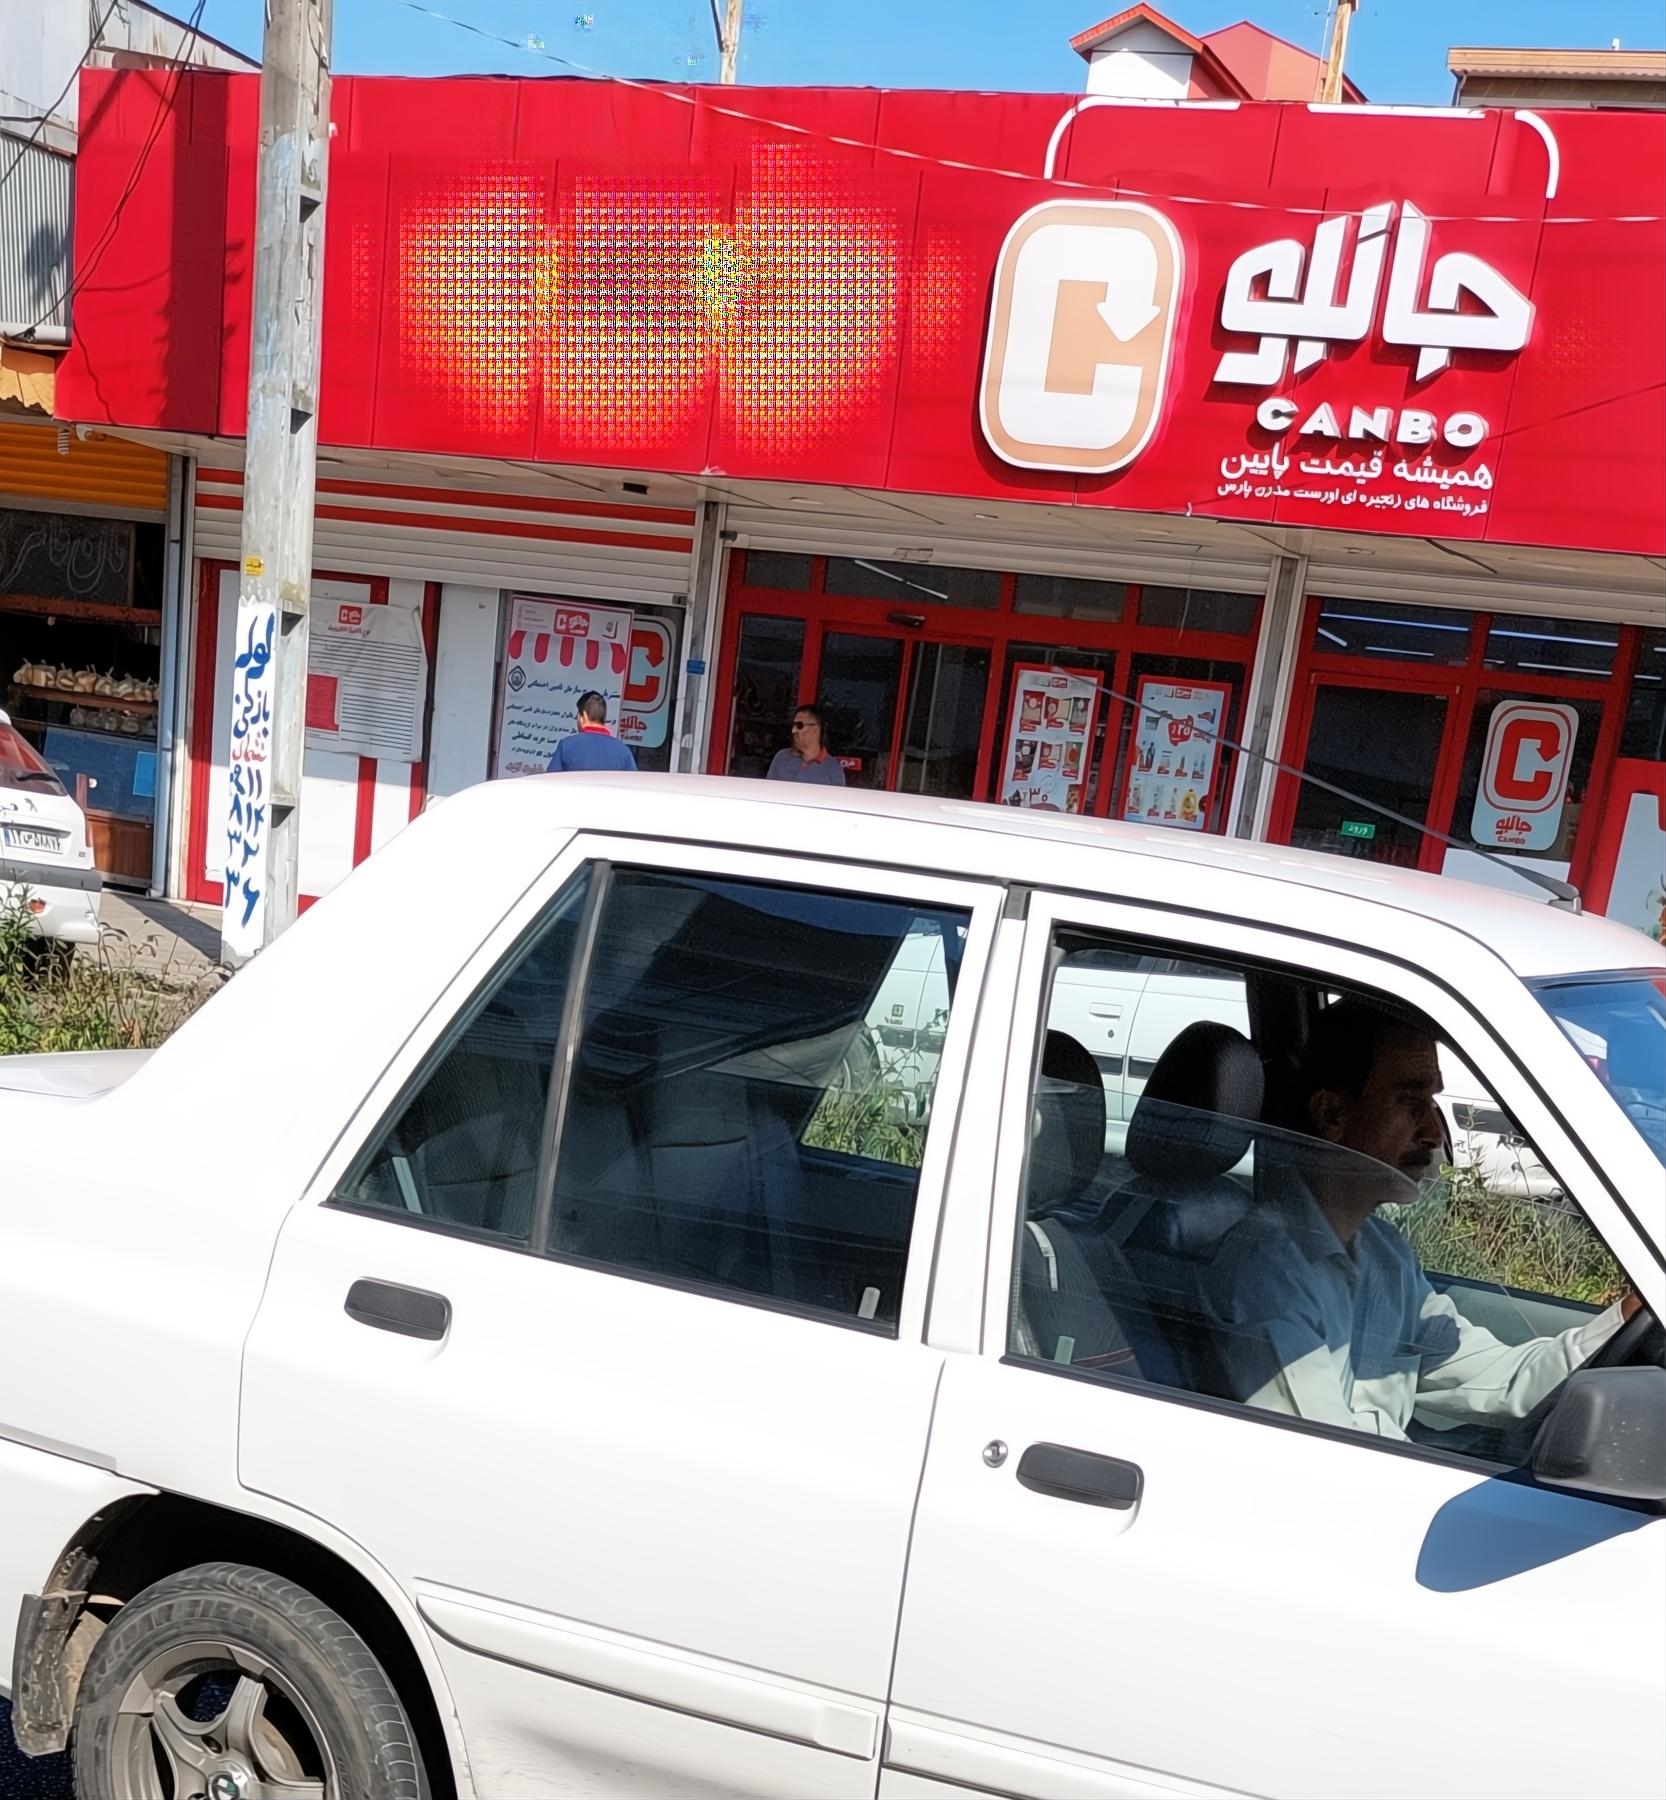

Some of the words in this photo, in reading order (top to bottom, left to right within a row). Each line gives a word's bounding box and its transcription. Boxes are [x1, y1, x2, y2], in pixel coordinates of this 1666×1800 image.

[1256, 396, 1489, 448] CANBO
[1220, 441, 1290, 479] پایین
[1300, 450, 1383, 479] قیمت
[1393, 453, 1494, 490] همیشه
[1217, 480, 1253, 498] پارس
[1293, 487, 1340, 504] اورست
[1340, 489, 1358, 504] ای
[1358, 493, 1402, 509] زنجیره
[1404, 493, 1430, 510] های
[1432, 494, 1489, 516] فروشگاه
[1348, 825, 1368, 836] ورود
